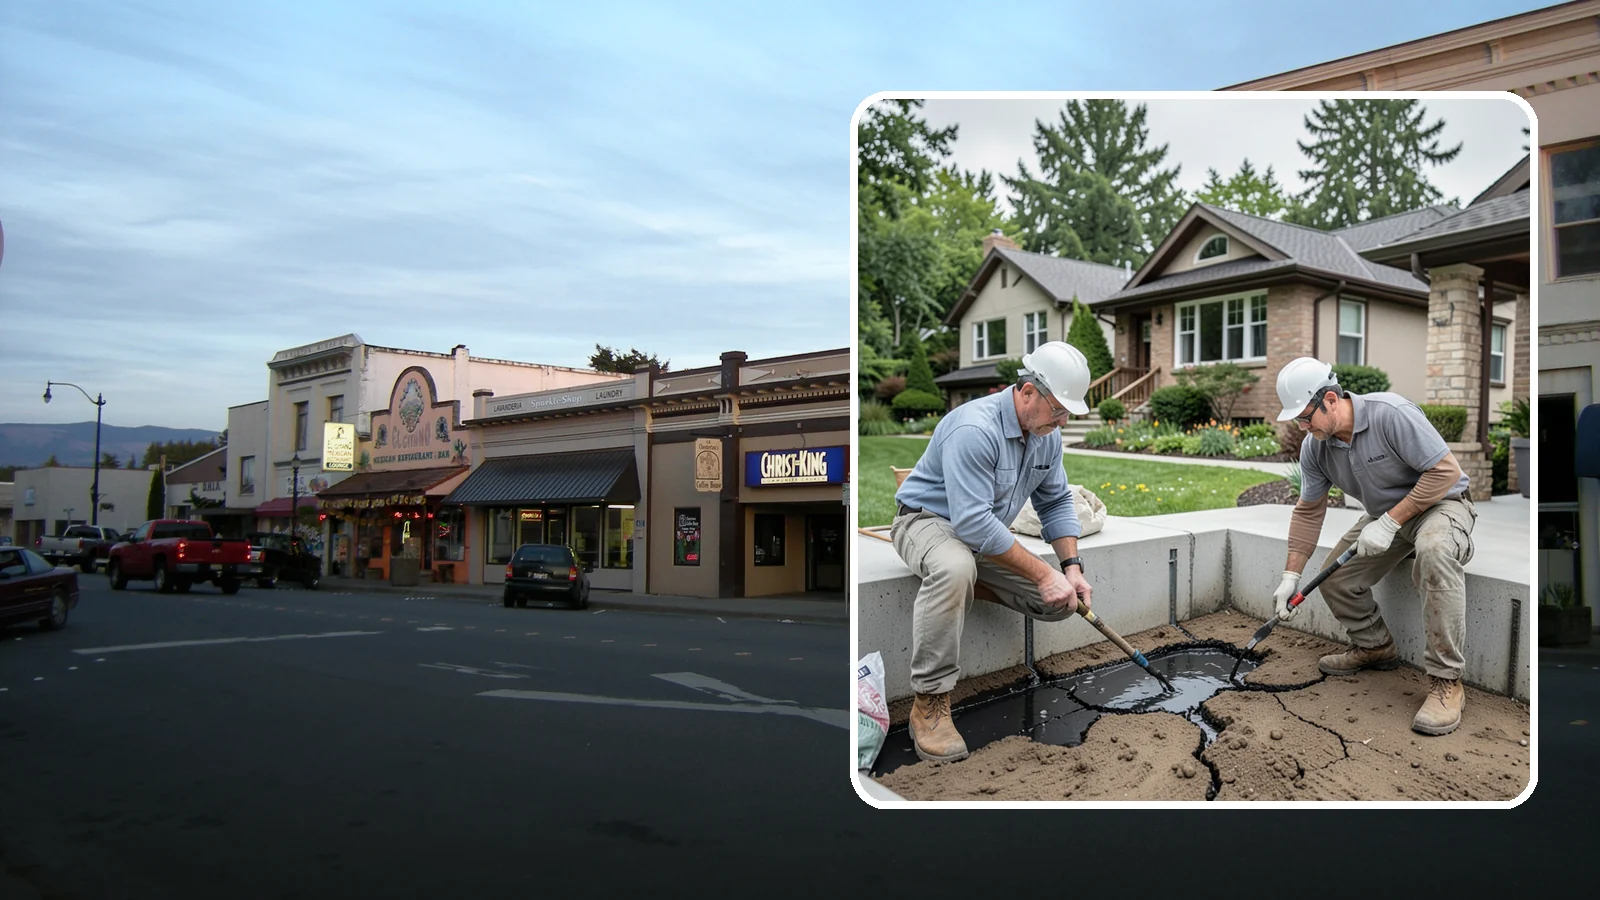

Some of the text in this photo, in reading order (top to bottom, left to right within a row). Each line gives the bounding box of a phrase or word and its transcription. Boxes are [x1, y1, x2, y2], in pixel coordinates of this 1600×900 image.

[561, 394, 582, 405] Shop
[595, 389, 623, 400] LAUNDRY
[494, 402, 522, 412] LAVANDERIA
[373, 450, 450, 464] MEXICAN RESTAURANT BAR
[761, 450, 827, 478] CHRIST KING
